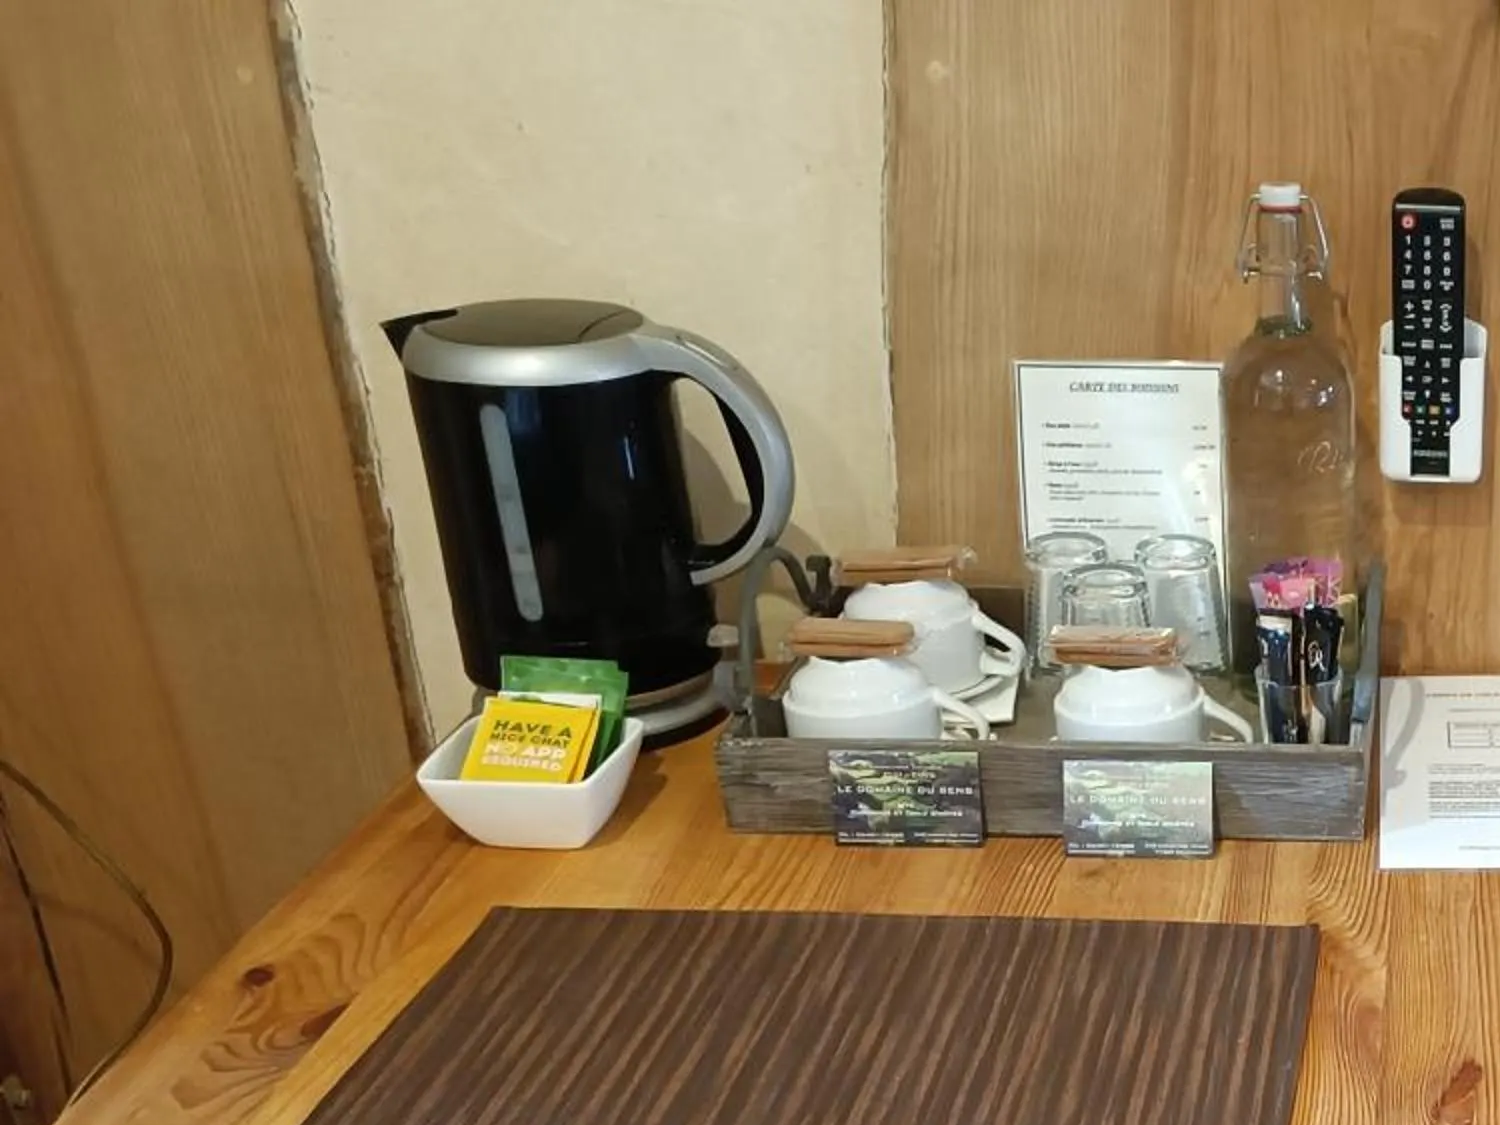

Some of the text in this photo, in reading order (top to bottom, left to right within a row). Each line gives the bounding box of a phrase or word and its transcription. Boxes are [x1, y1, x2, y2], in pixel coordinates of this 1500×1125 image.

[1404, 264, 1412, 275] 7
[493, 719, 572, 739] HAVE A
[530, 735, 570, 749] CHAT
[520, 745, 567, 760] APP
